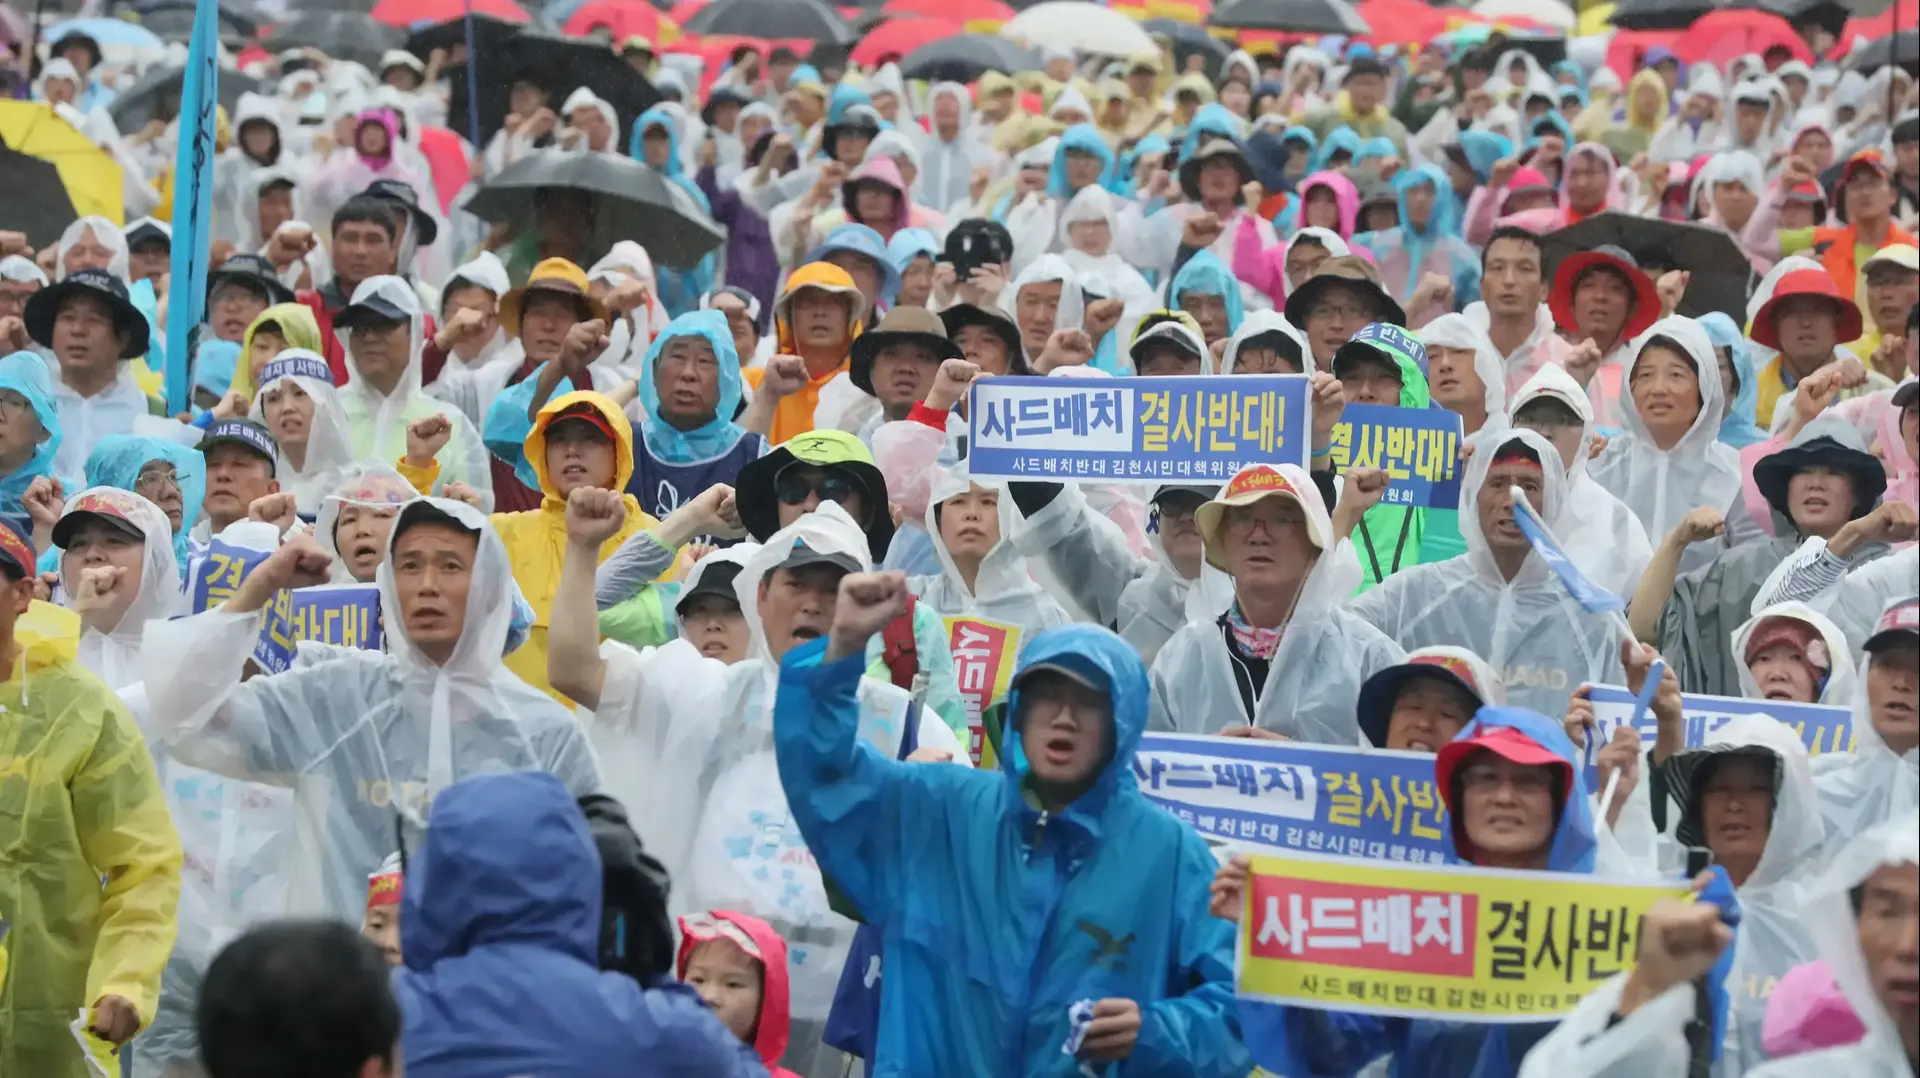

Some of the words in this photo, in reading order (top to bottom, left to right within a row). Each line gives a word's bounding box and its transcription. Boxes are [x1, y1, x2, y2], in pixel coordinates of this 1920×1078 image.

[981, 390, 1124, 442] 사드배치
[1139, 390, 1286, 453] 결사반대!
[1012, 457, 1106, 474] 사드배치반대
[1112, 460, 1257, 477] 김천시민대책위원
[1330, 421, 1457, 482] 결사반대!
[1133, 756, 1305, 801] 사드배치
[1257, 892, 1464, 956] 사드배치
[1488, 899, 1648, 983] 결사반
[1301, 974, 1438, 1007] 사드배치반대
